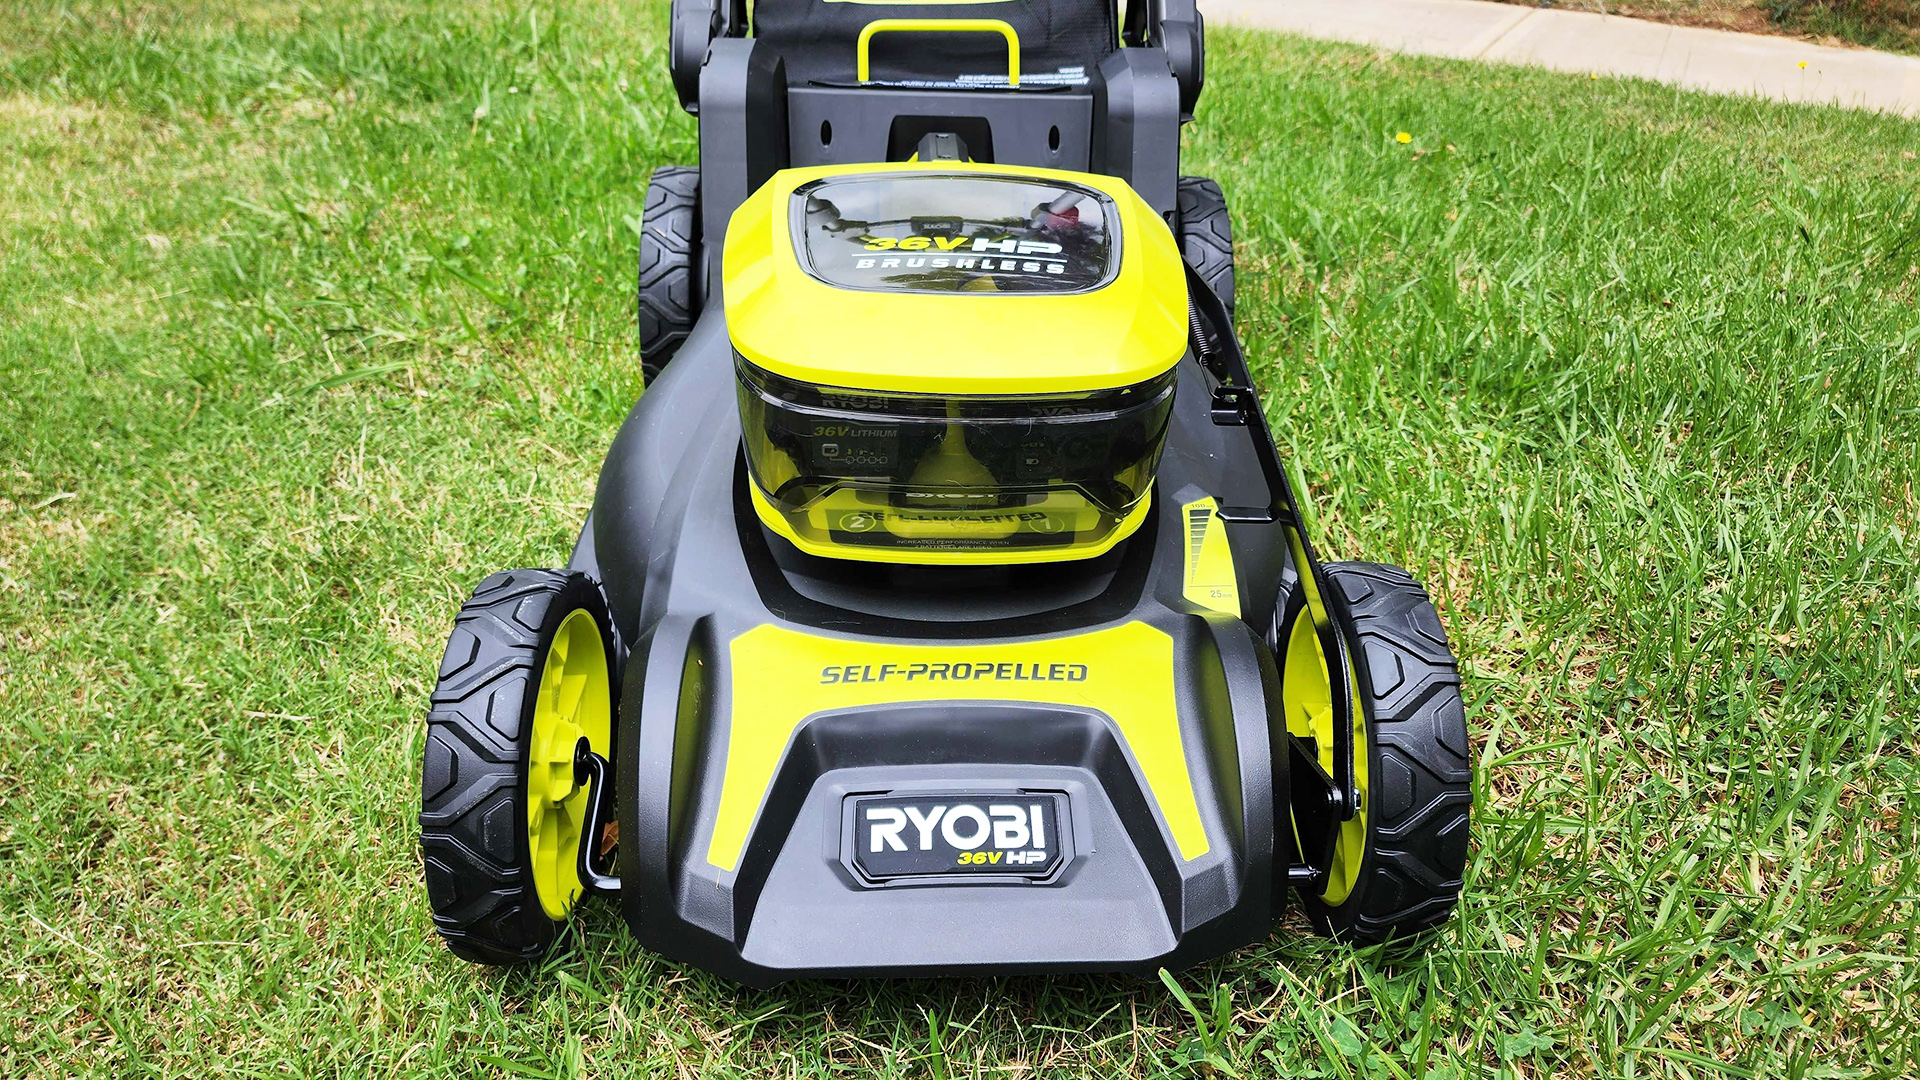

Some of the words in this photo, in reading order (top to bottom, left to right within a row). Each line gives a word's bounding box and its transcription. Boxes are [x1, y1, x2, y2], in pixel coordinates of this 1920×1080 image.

[863, 236, 968, 251] 36V
[971, 237, 1063, 254] HP
[856, 258, 1065, 274] BRUSHLESS
[813, 426, 850, 437] 36V
[851, 429, 898, 438] LITHIUM
[850, 516, 865, 528] 2
[820, 663, 1087, 684] SELF-PROPELLED
[866, 804, 1046, 853] RYOBI
[957, 851, 1003, 865] 36V
[1005, 851, 1048, 865] HP
